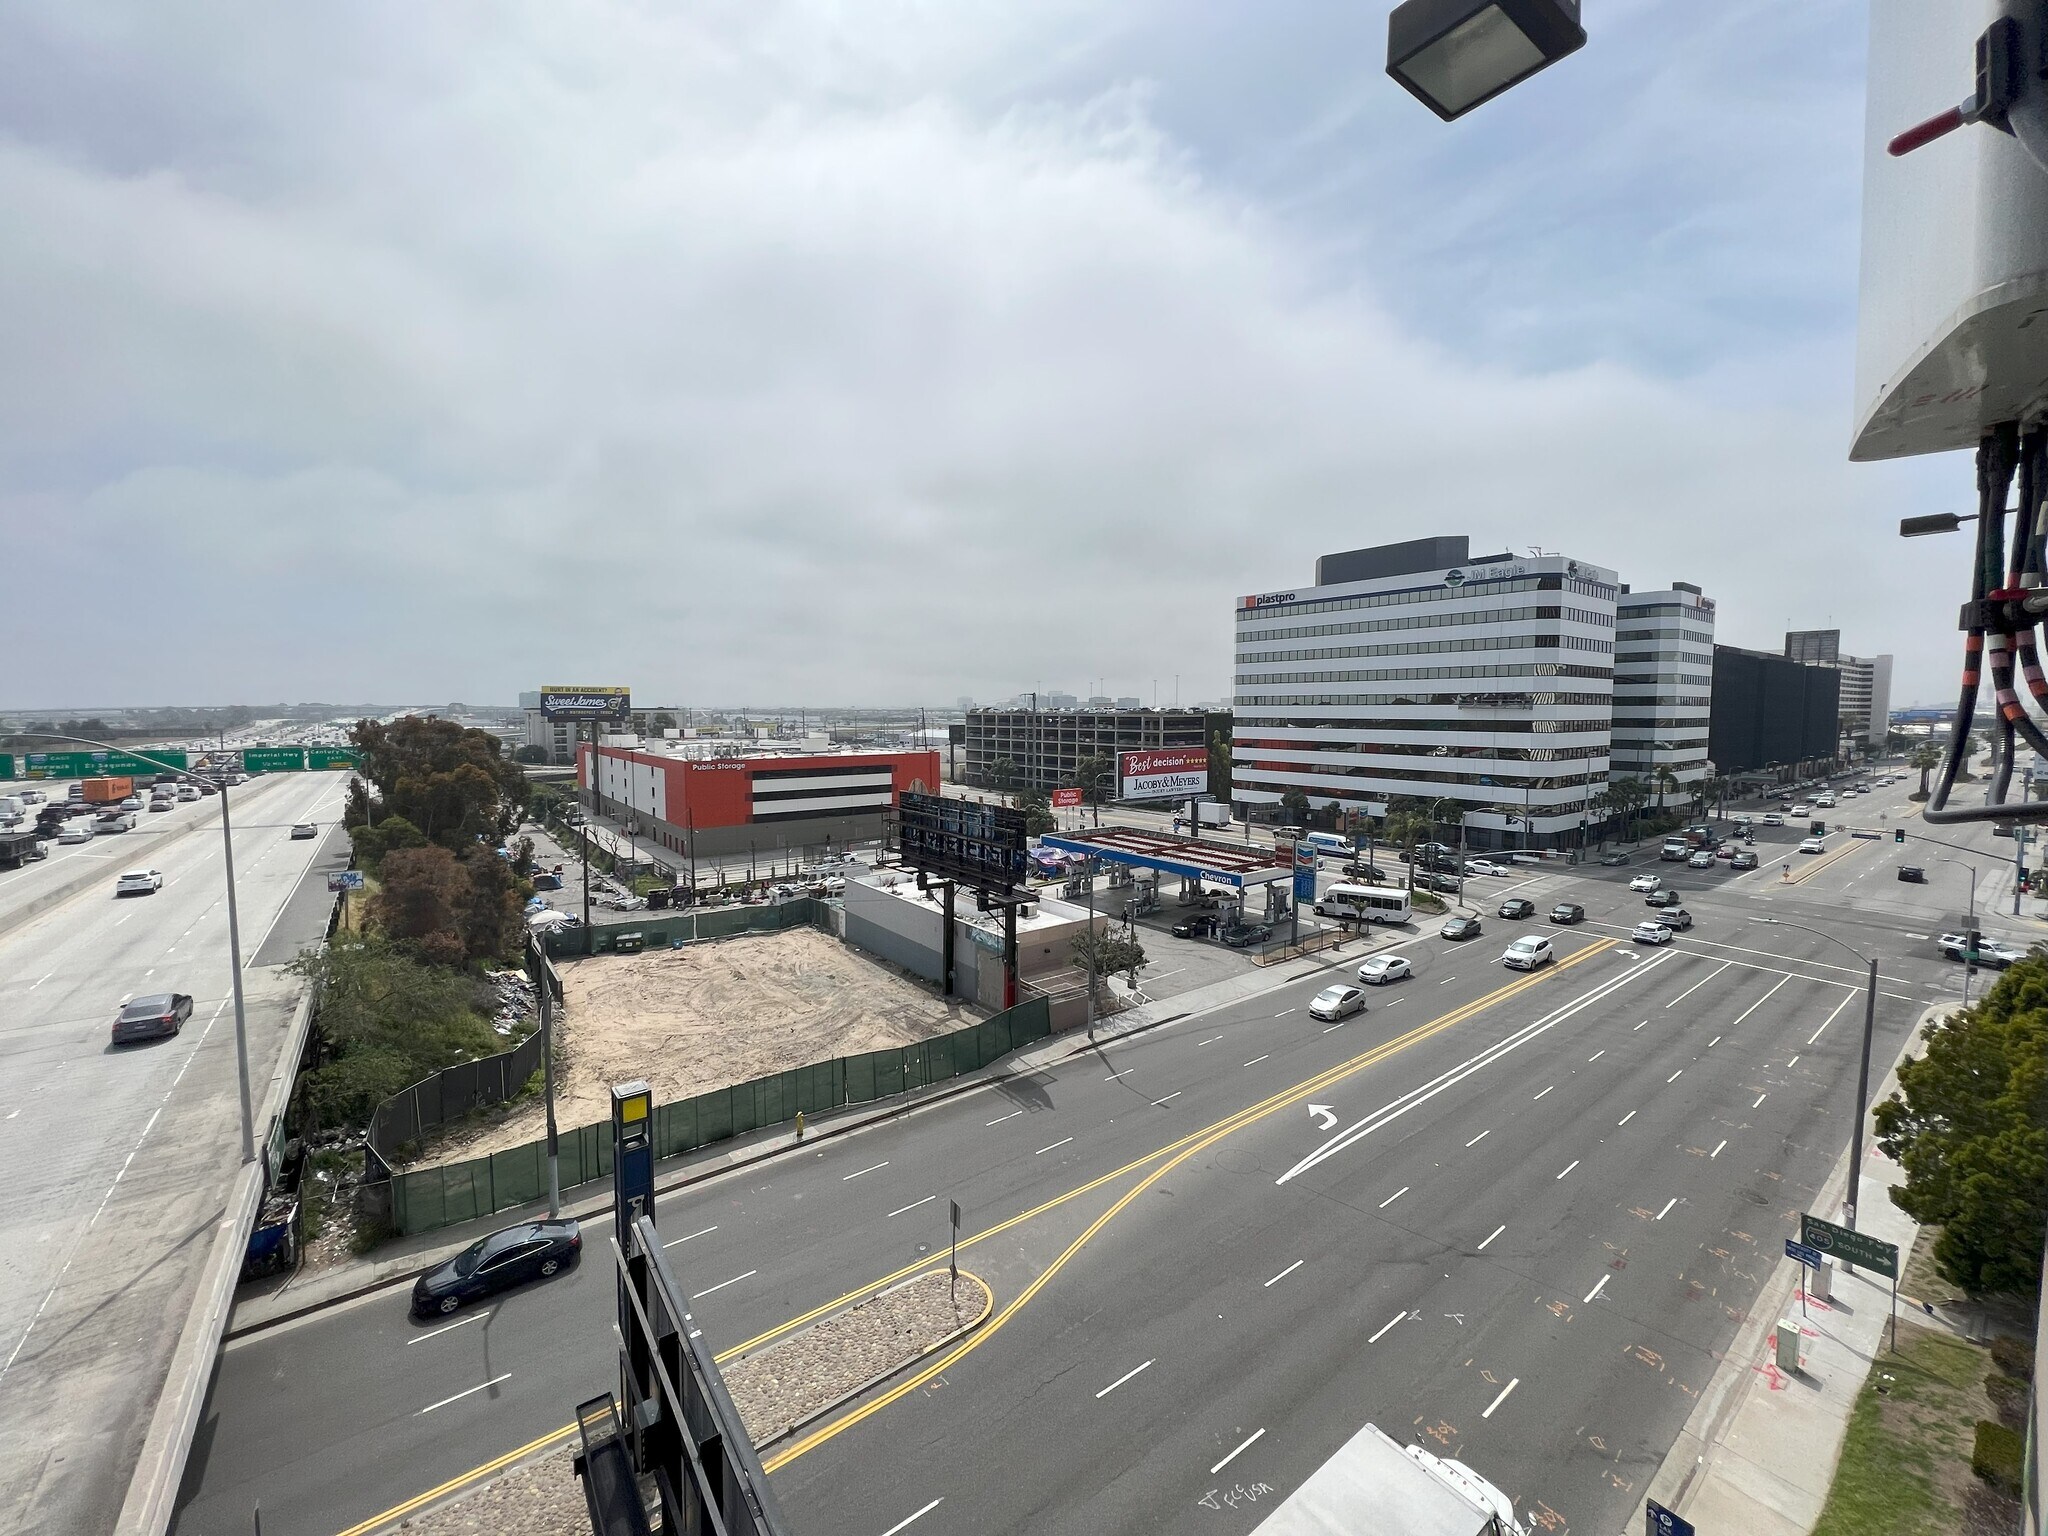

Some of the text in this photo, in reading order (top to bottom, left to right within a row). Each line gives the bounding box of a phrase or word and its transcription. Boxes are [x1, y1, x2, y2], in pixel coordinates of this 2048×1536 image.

[1467, 565, 1525, 580] JM Eagle
[1257, 593, 1296, 608] plastpro
[1057, 797, 1079, 805] Storage
[1199, 870, 1232, 885] Chevron
[1807, 1218, 1892, 1254] San Diego Fwy
[1838, 1242, 1872, 1259] SOUTH
